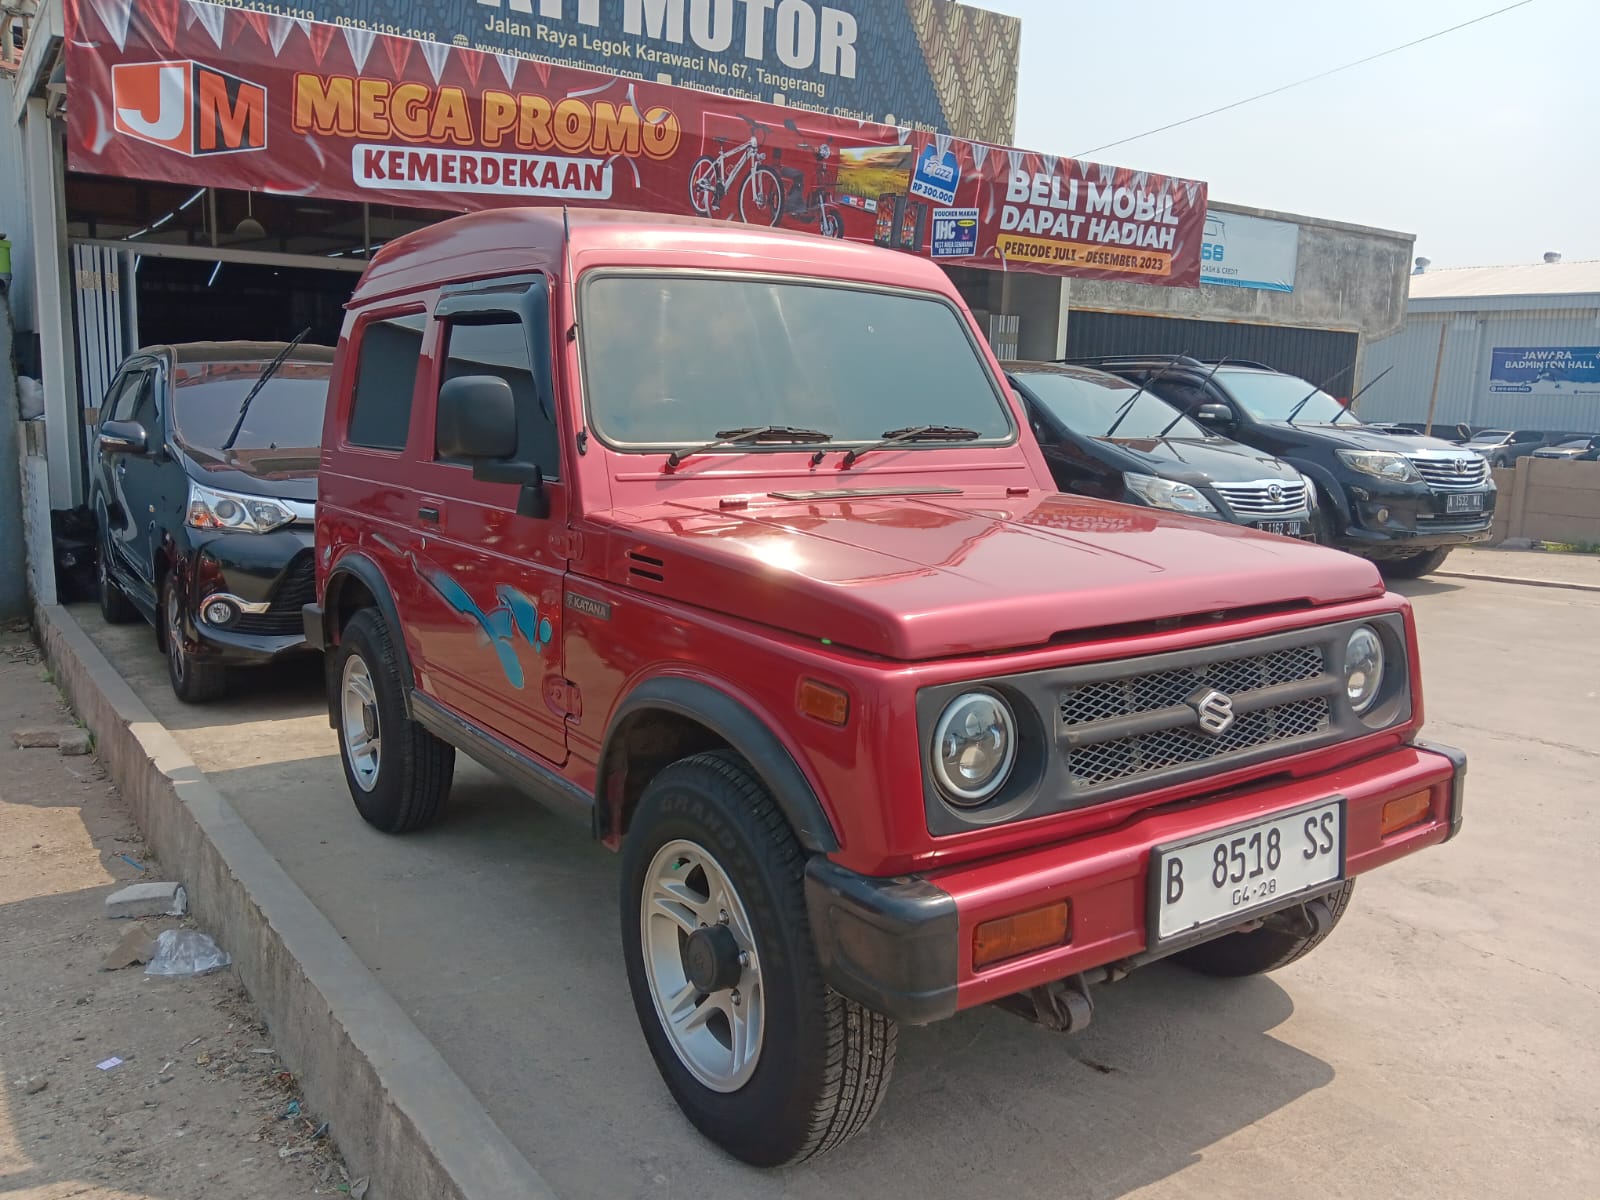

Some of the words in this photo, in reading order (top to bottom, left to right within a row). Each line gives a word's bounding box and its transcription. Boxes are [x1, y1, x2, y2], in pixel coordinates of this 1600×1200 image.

[484, 14, 531, 38] Jalan
[536, 24, 577, 48] Raya
[583, 33, 631, 57] Legok
[636, 43, 704, 71] Karawaci
[708, 58, 752, 83] No.67,
[756, 68, 825, 97] Tangerang
[623, 0, 858, 79] MOTOR
[293, 72, 475, 145] MEGA
[481, 89, 681, 161] PROMO
[915, 121, 939, 133] Motor
[364, 149, 603, 191] KEMERDEKAAN
[923, 185, 953, 203] 300.000
[1006, 169, 1078, 211] BELI
[1086, 181, 1179, 225] MOBIL
[935, 220, 956, 240] IHC
[1000, 205, 1085, 239] DAPAT
[1087, 218, 1176, 250] HADIAH
[1004, 241, 1051, 259] PERIODE
[1053, 246, 1076, 261] JULI
[1085, 250, 1138, 268] DESEMBER
[1139, 256, 1163, 271] 2023
[1505, 361, 1565, 369] BADMINTON
[1567, 361, 1595, 369] HALL
[574, 597, 606, 617] KATANA
[1166, 857, 1184, 905] B
[1212, 827, 1281, 889] 8518
[1302, 811, 1334, 860] SS
